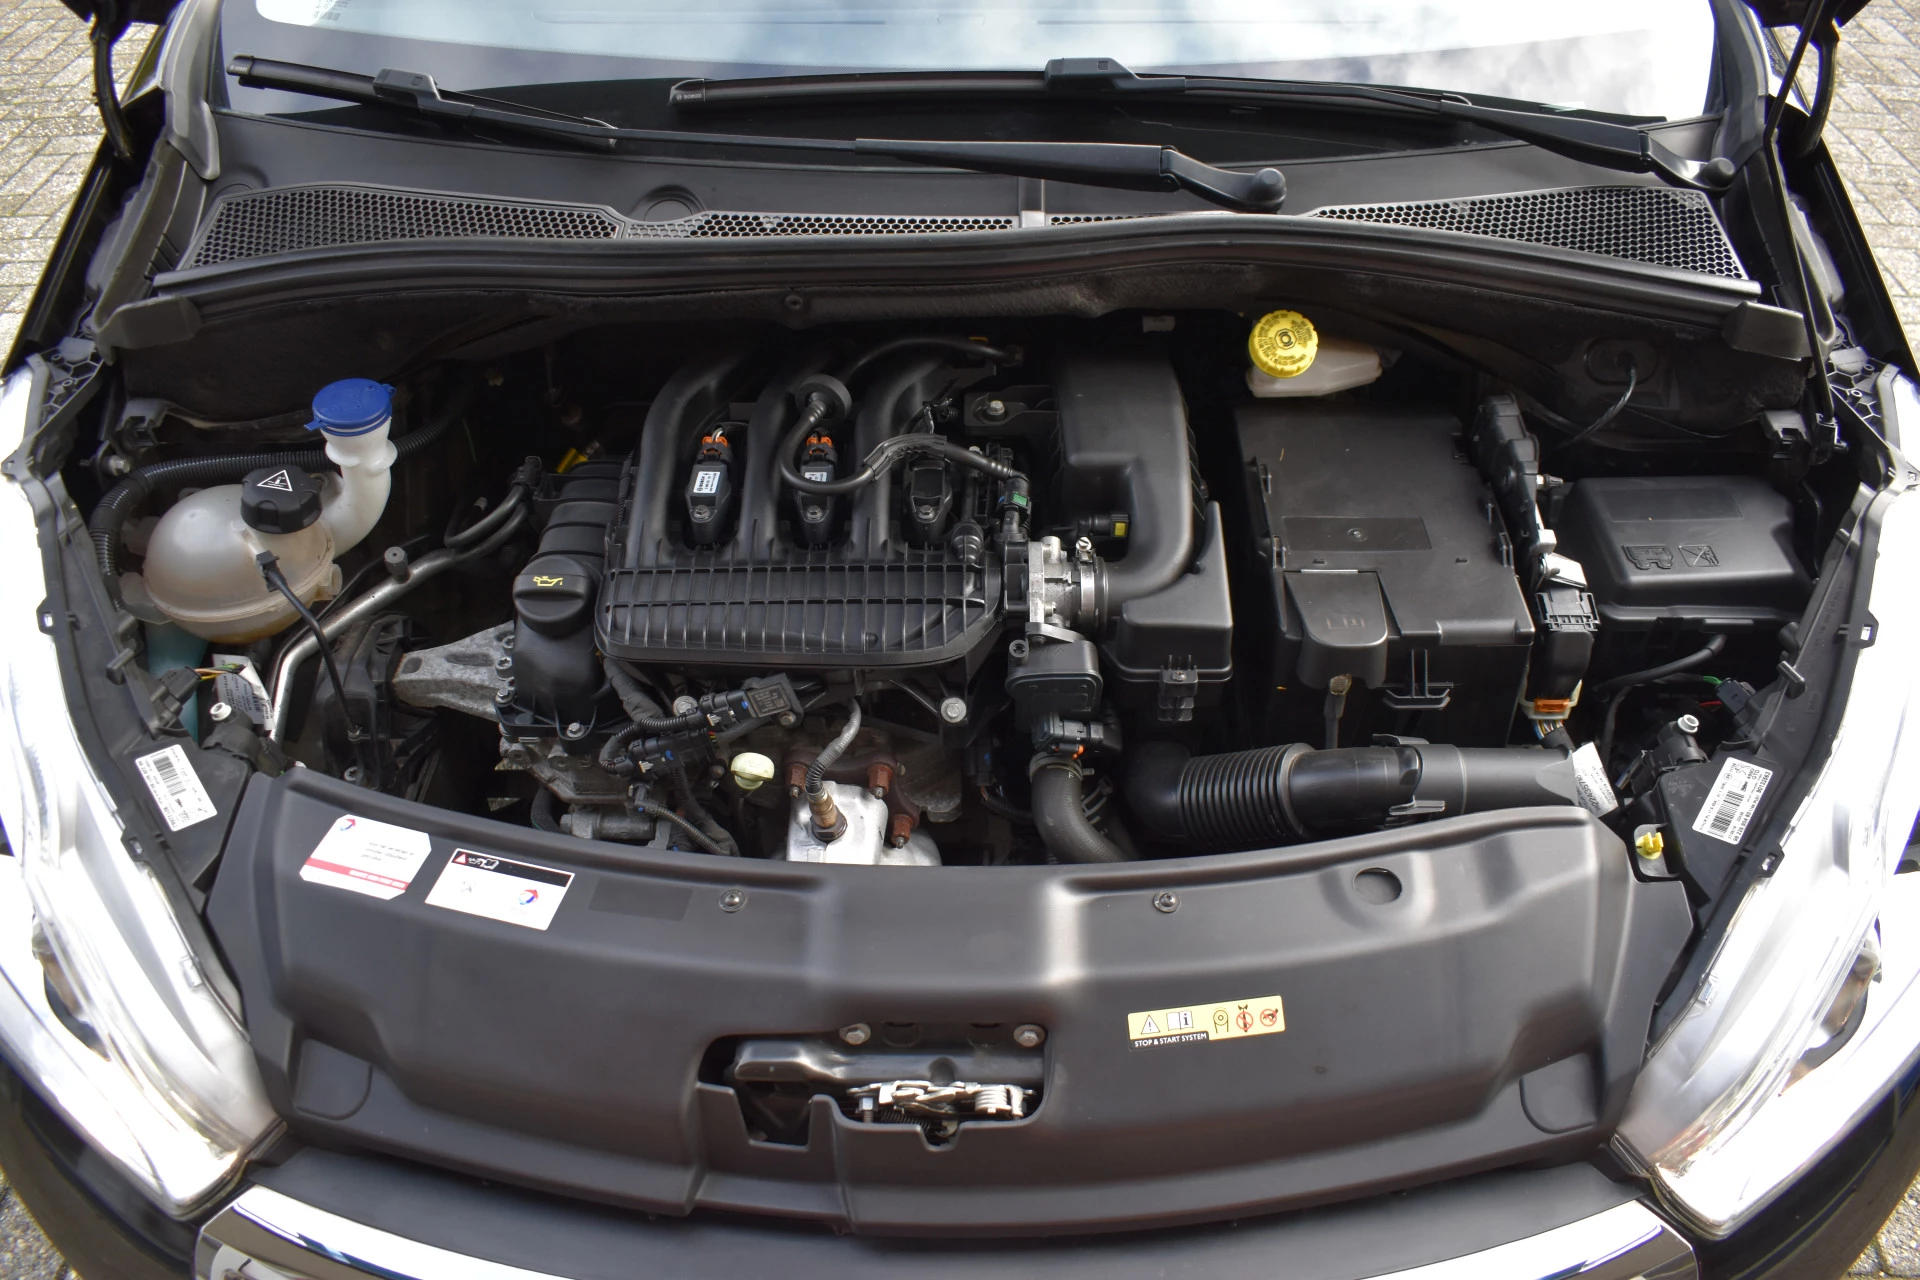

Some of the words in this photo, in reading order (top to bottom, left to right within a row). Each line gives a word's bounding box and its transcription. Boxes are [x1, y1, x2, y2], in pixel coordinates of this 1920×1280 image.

[1134, 1038, 1152, 1048] STOP
[1159, 1035, 1180, 1044] START
[1181, 1033, 1207, 1042] SYSTEM
